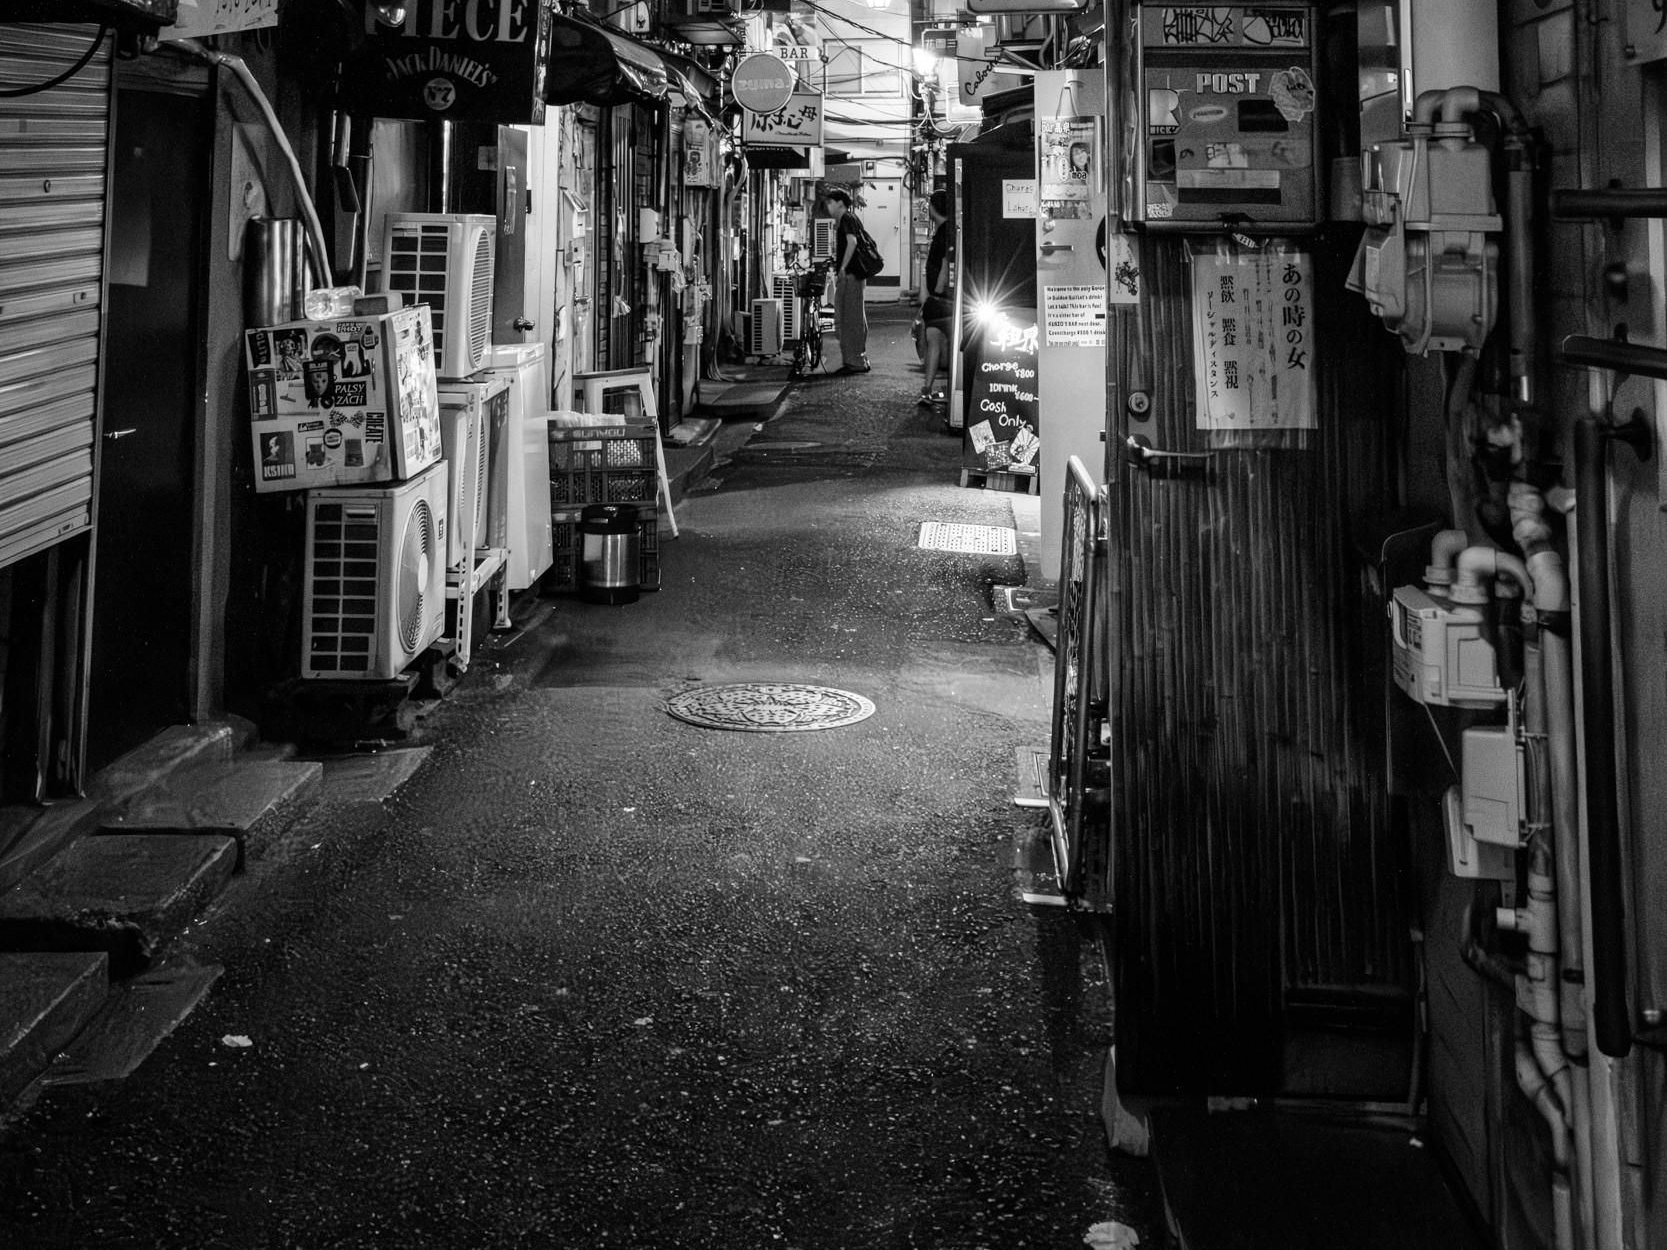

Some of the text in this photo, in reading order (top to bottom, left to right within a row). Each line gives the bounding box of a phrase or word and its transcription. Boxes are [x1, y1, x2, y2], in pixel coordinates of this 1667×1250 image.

[780, 48, 808, 58] BAR
[1196, 73, 1260, 93] POST
[1283, 263, 1306, 370] あの時の女
[981, 362, 1035, 378] Charge ¥800
[335, 384, 365, 393] PALSY
[336, 395, 364, 405] ZACH
[980, 398, 1007, 413] Cash
[366, 412, 384, 444] CREATE
[998, 413, 1026, 429] Only
